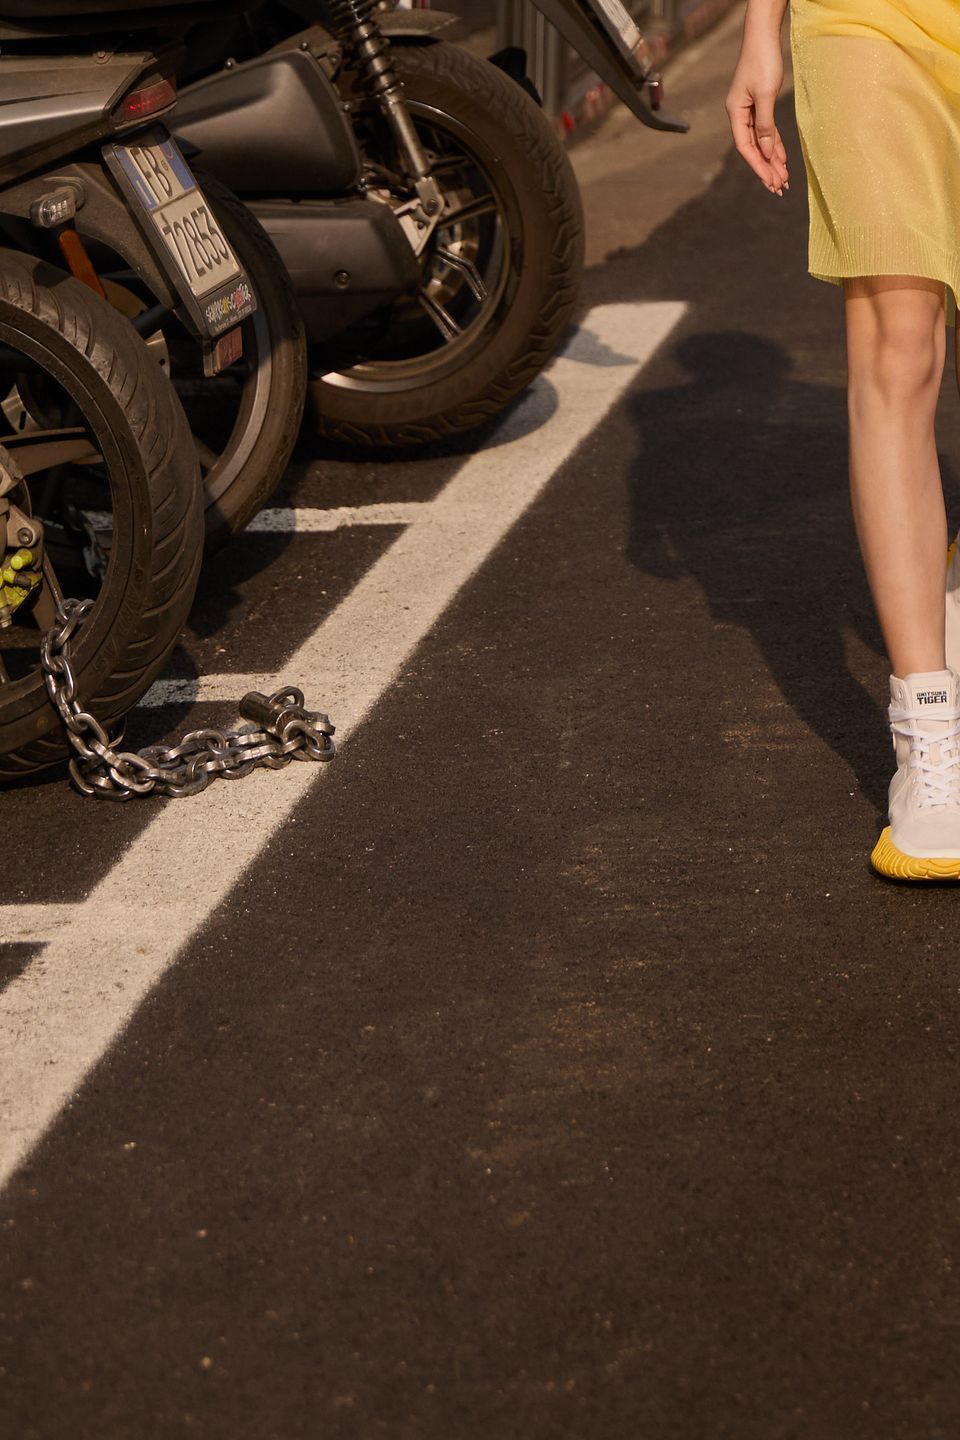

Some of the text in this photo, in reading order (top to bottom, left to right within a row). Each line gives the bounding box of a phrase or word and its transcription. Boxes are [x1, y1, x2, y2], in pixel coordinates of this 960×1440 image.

[129, 146, 173, 203] FB
[162, 205, 230, 284] 72853
[917, 695, 947, 705] TIGER
